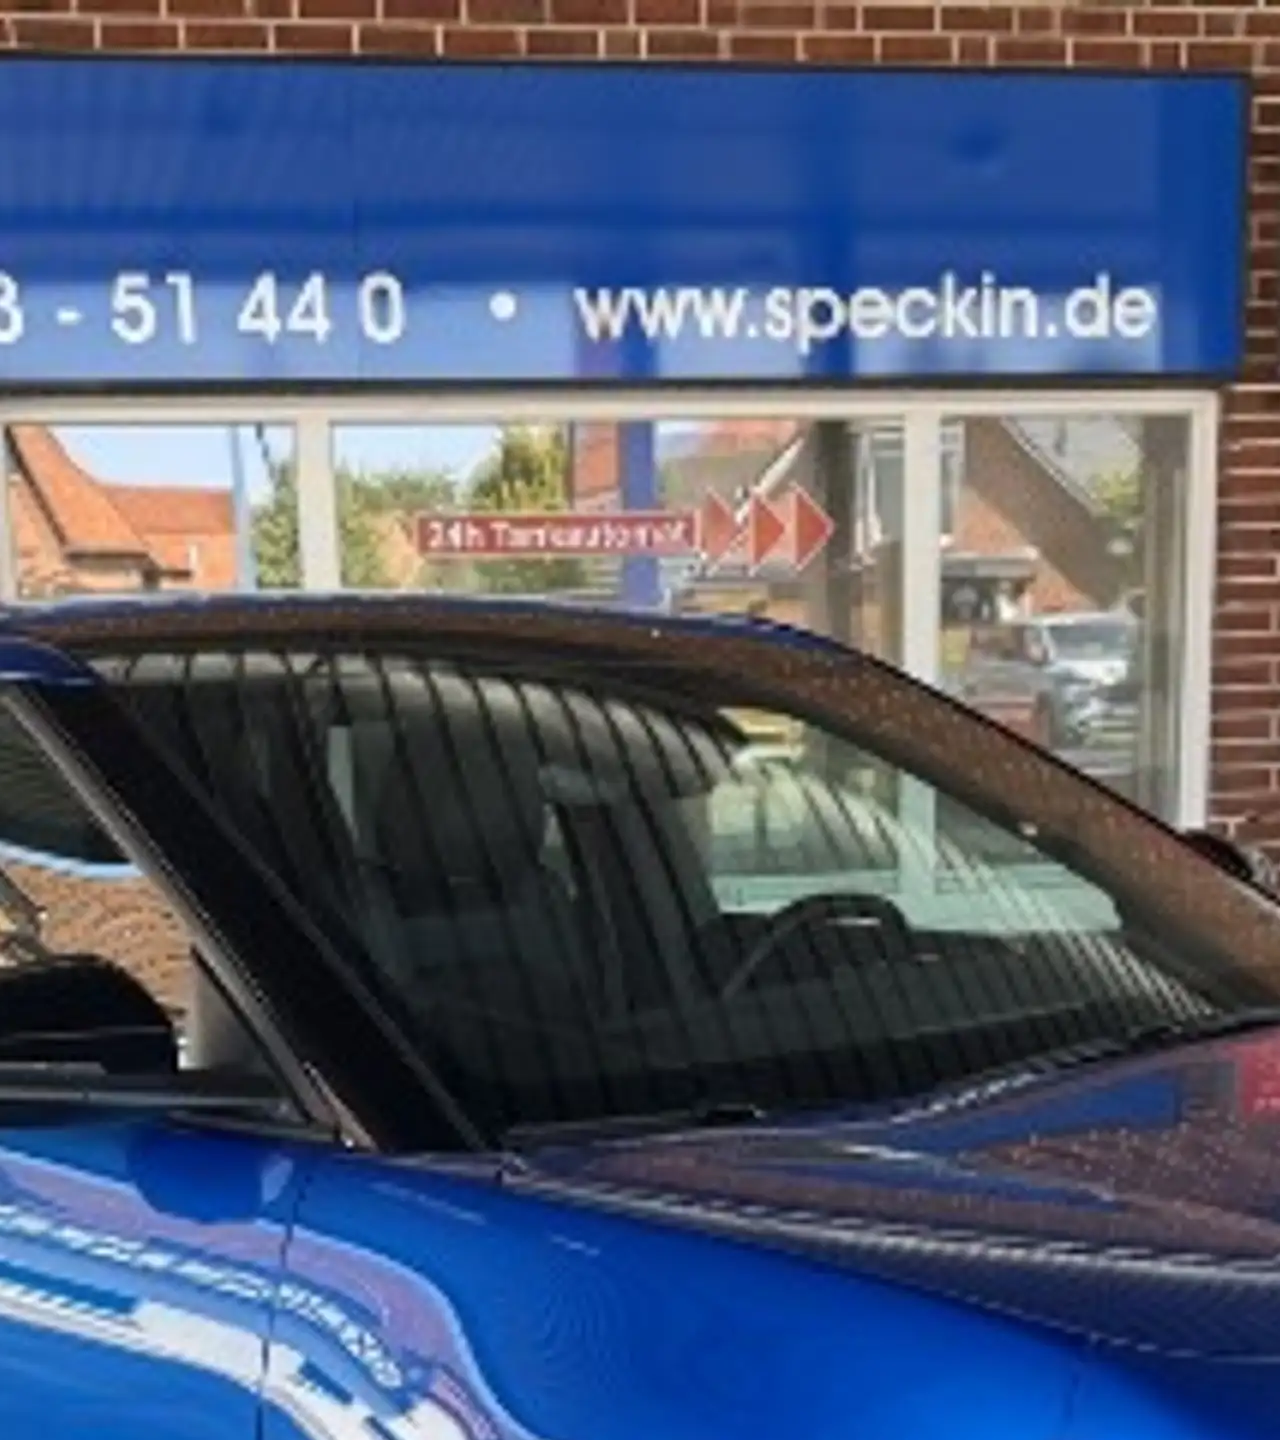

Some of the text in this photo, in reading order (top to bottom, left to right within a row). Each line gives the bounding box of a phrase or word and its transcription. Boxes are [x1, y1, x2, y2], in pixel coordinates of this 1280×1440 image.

[110, 274, 196, 344] 51
[238, 274, 332, 343] 44
[358, 274, 404, 343] 0
[573, 273, 1159, 352] www.speckin.de
